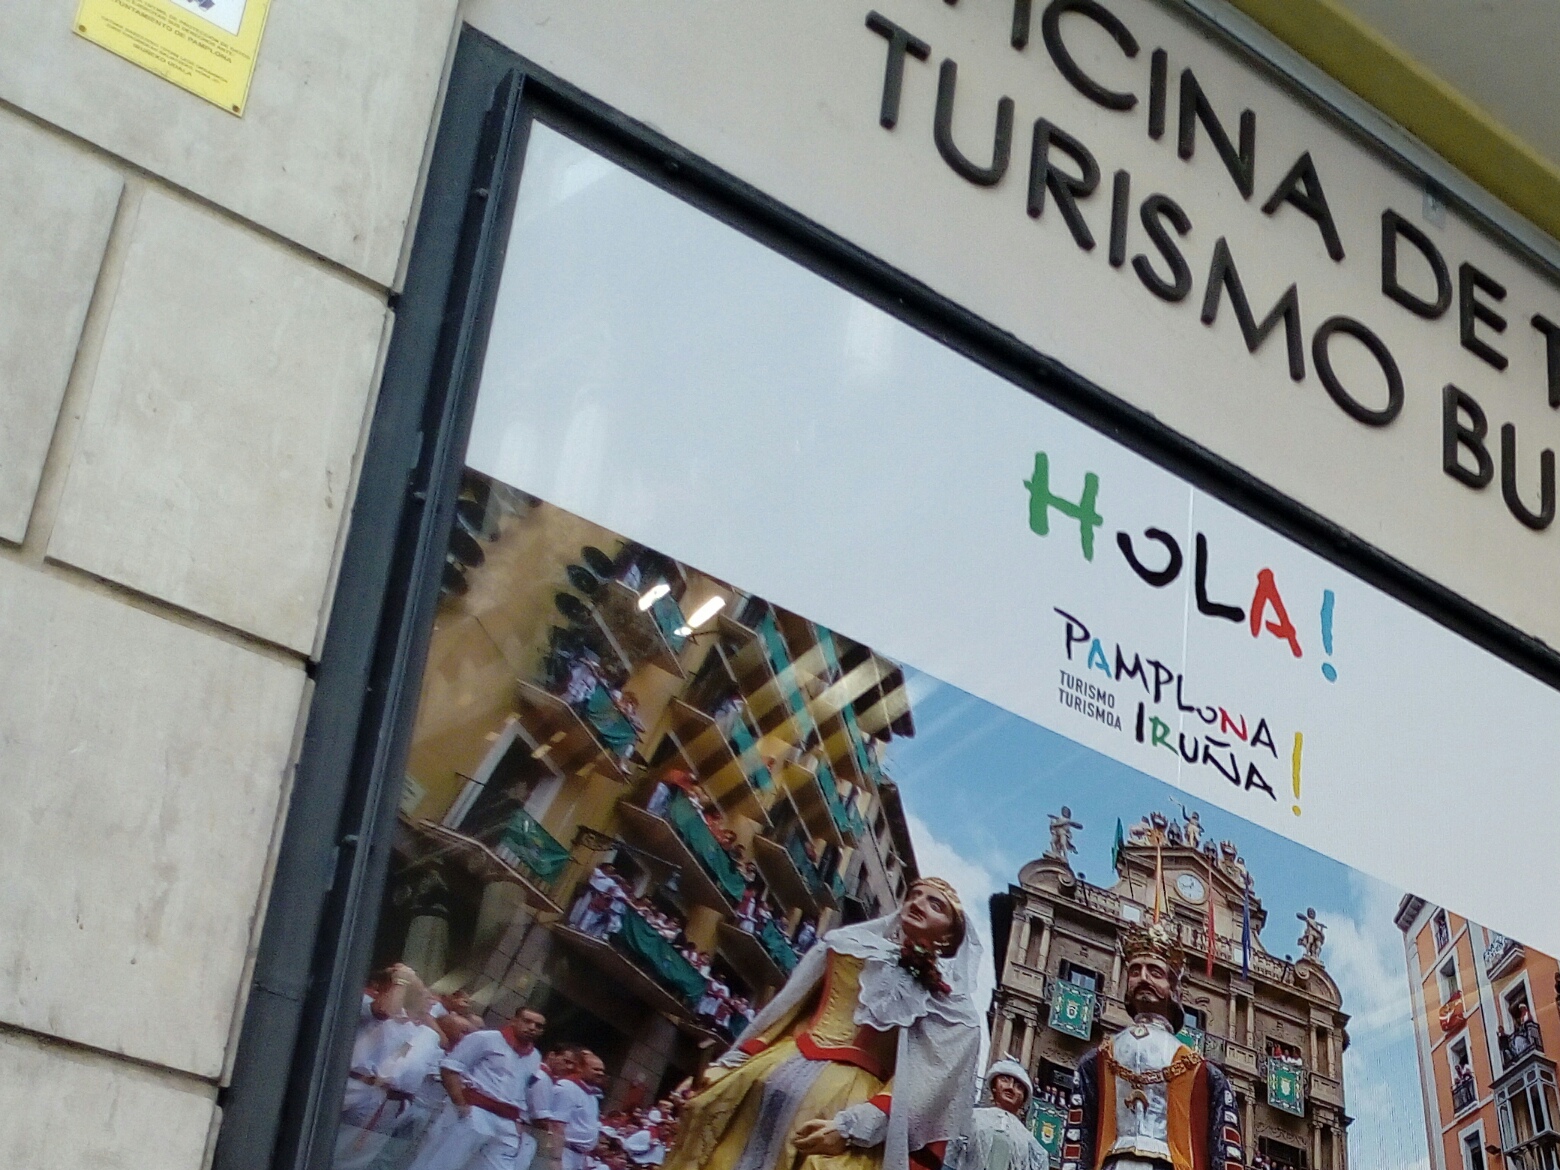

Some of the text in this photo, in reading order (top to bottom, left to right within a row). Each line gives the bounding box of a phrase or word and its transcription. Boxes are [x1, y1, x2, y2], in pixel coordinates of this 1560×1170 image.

[865, 10, 1405, 428] TURISMO
[941, 0, 1345, 262] ICINA
[1381, 208, 1507, 371] DE
[1023, 451, 1338, 683] HOLA!
[1053, 606, 1279, 760] PAMPLONA
[1058, 686, 1122, 733] TURISMOA
[1059, 669, 1116, 709] TURISMO
